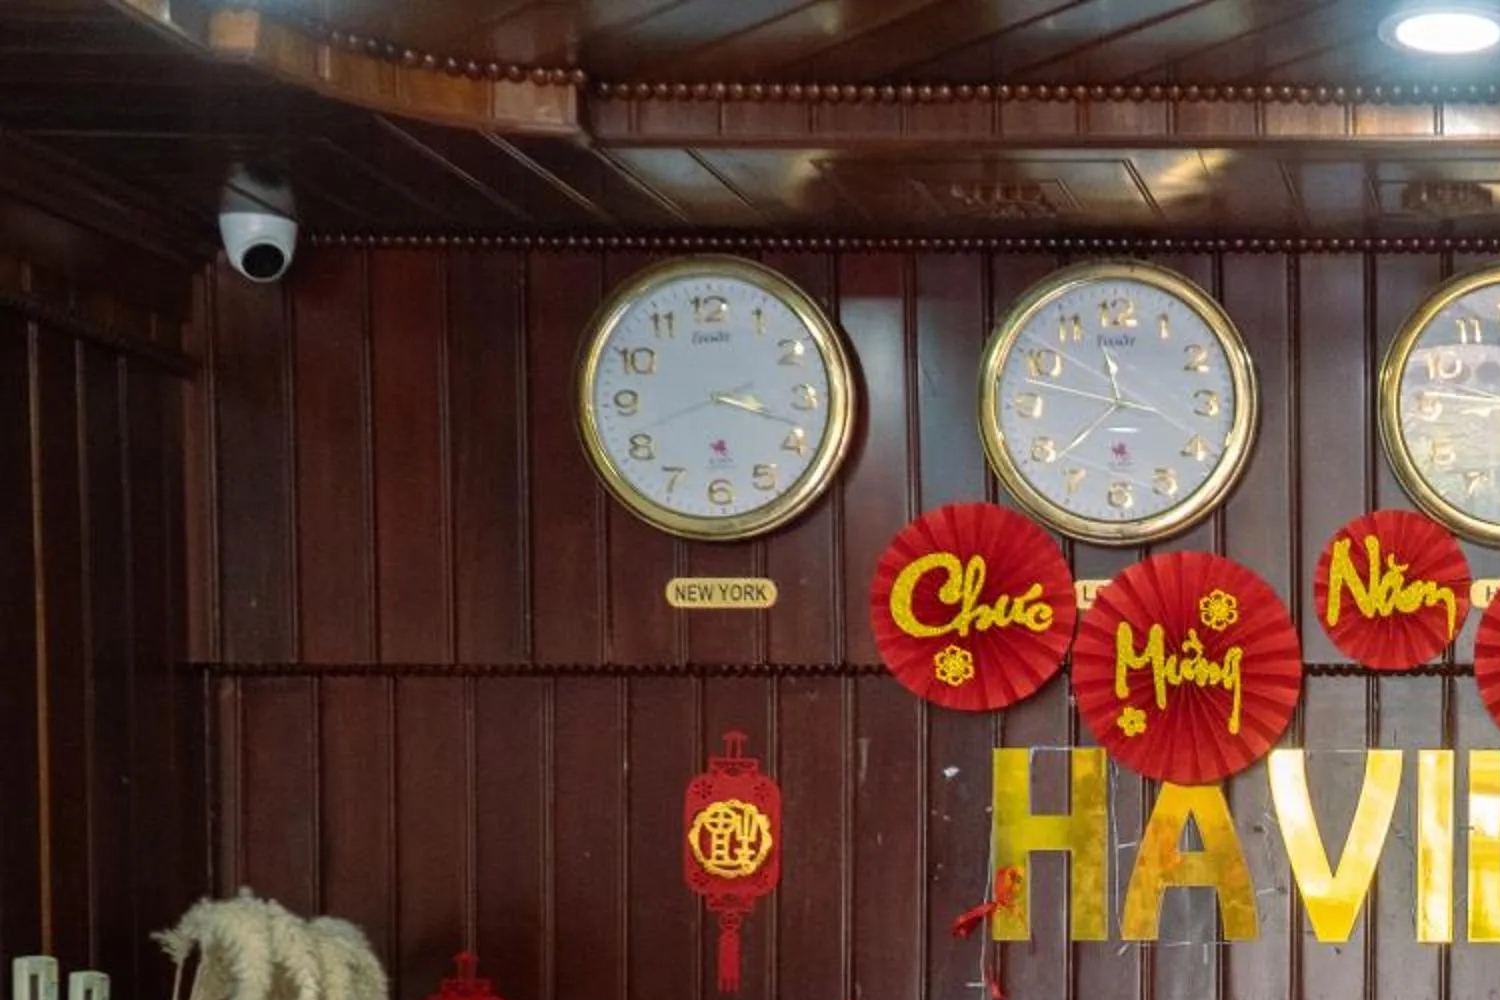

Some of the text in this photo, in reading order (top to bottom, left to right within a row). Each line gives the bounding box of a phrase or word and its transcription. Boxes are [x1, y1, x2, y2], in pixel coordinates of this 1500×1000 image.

[690, 296, 727, 322] 12
[753, 308, 766, 334] 1
[651, 312, 674, 338] 11
[618, 347, 655, 374] 10
[777, 339, 804, 365] 2
[614, 389, 638, 416] 9
[791, 384, 817, 411] 3
[628, 433, 655, 461] 8
[781, 428, 804, 455] 4
[662, 466, 686, 493] 7
[753, 464, 776, 491] 5
[708, 478, 732, 505] 6
[675, 584, 768, 601] NEW YORK
[890, 552, 1054, 638] Chúc
[1327, 535, 1455, 641] Năm
